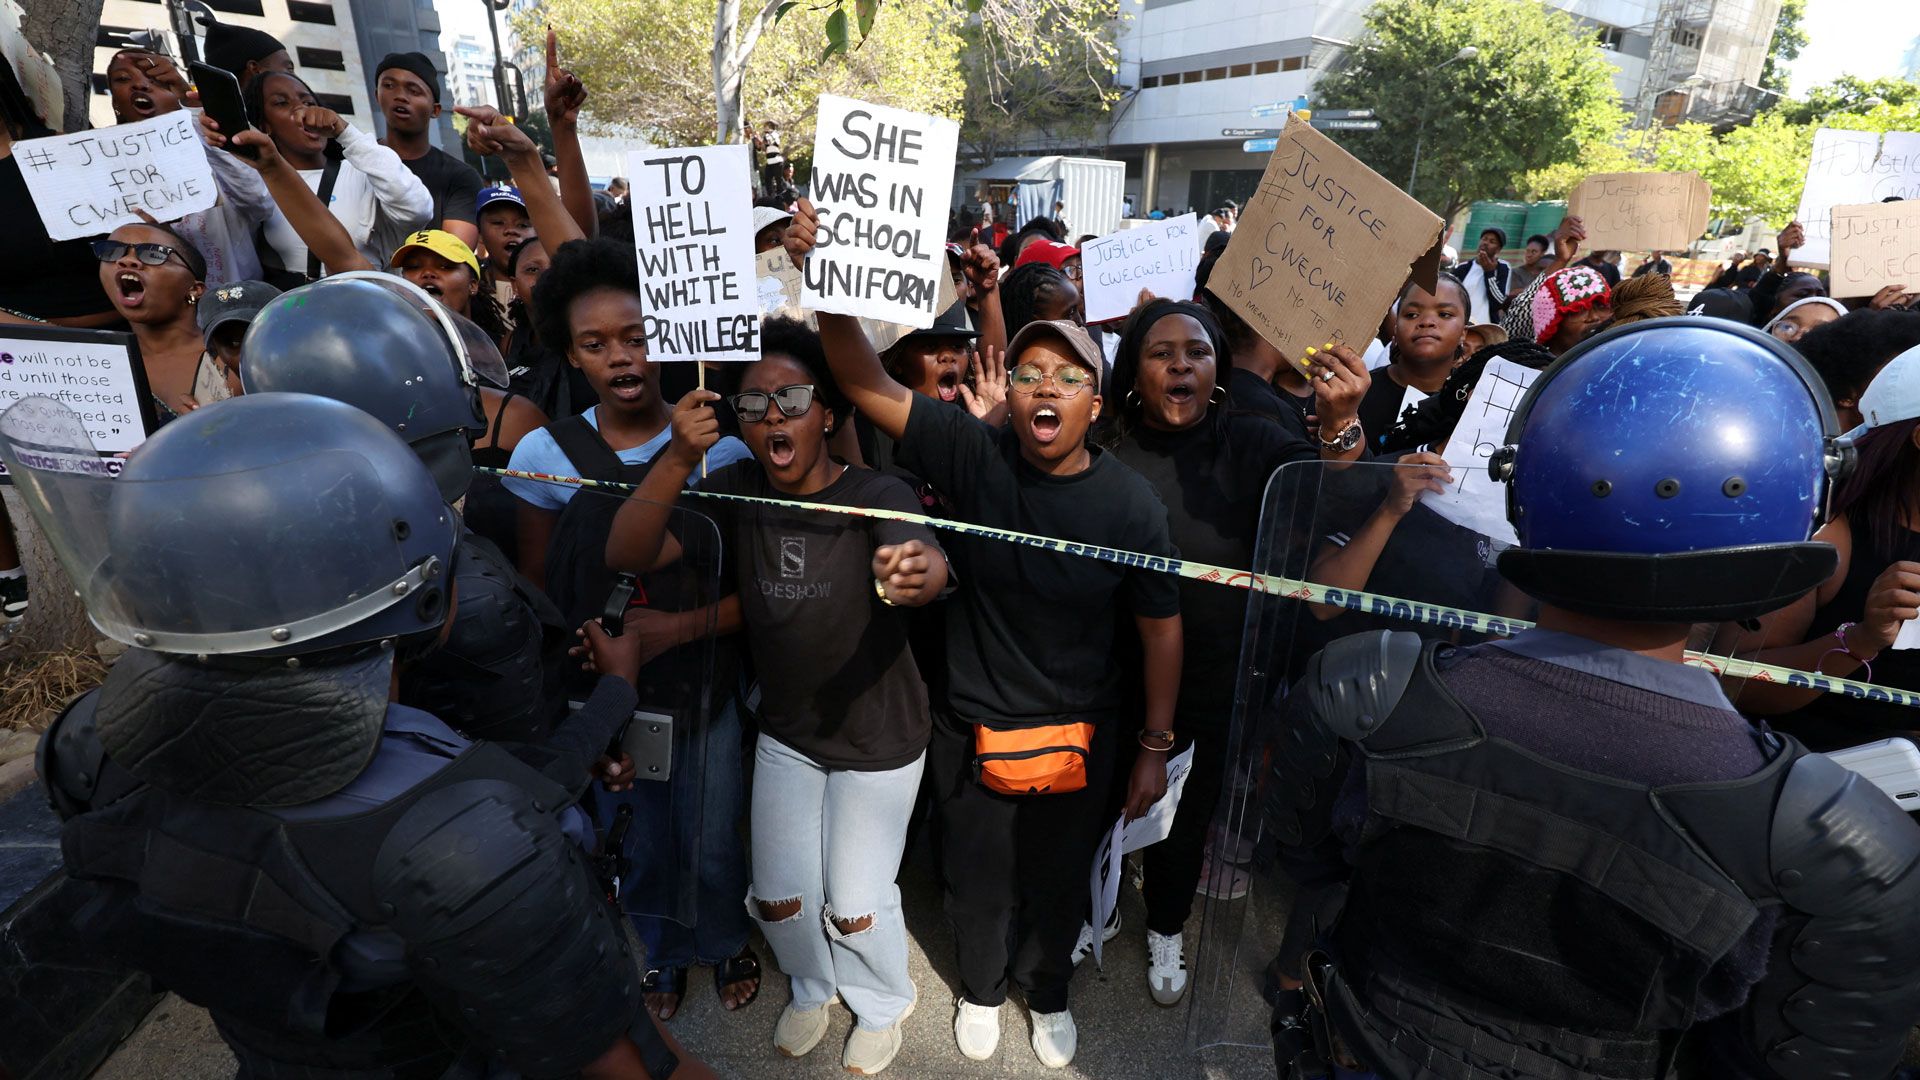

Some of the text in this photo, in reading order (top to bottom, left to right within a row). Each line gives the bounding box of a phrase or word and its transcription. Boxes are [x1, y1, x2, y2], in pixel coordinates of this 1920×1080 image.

[68, 120, 193, 166] JUSTICE
[831, 110, 923, 165] SHE
[109, 164, 165, 192] FOR
[644, 155, 706, 196] TO
[812, 166, 923, 217] WAS IN
[1284, 137, 1387, 240] JUSTICE
[68, 179, 200, 226] CWECWE
[646, 201, 727, 243] HELL
[814, 207, 931, 260] SCHOOL
[1166, 225, 1188, 239] FOR
[1299, 204, 1334, 249] FOR
[638, 243, 721, 277] WITH
[1265, 221, 1347, 307] CWECWE
[645, 272, 739, 311] WHITE
[805, 256, 935, 313] UNIFORM
[642, 314, 759, 355] PRIVILEGE
[19, 352, 48, 364] will
[54, 354, 82, 367] not
[88, 355, 111, 369] be
[20, 371, 57, 384] until
[61, 373, 111, 386] those
[112, 413, 132, 424] as
